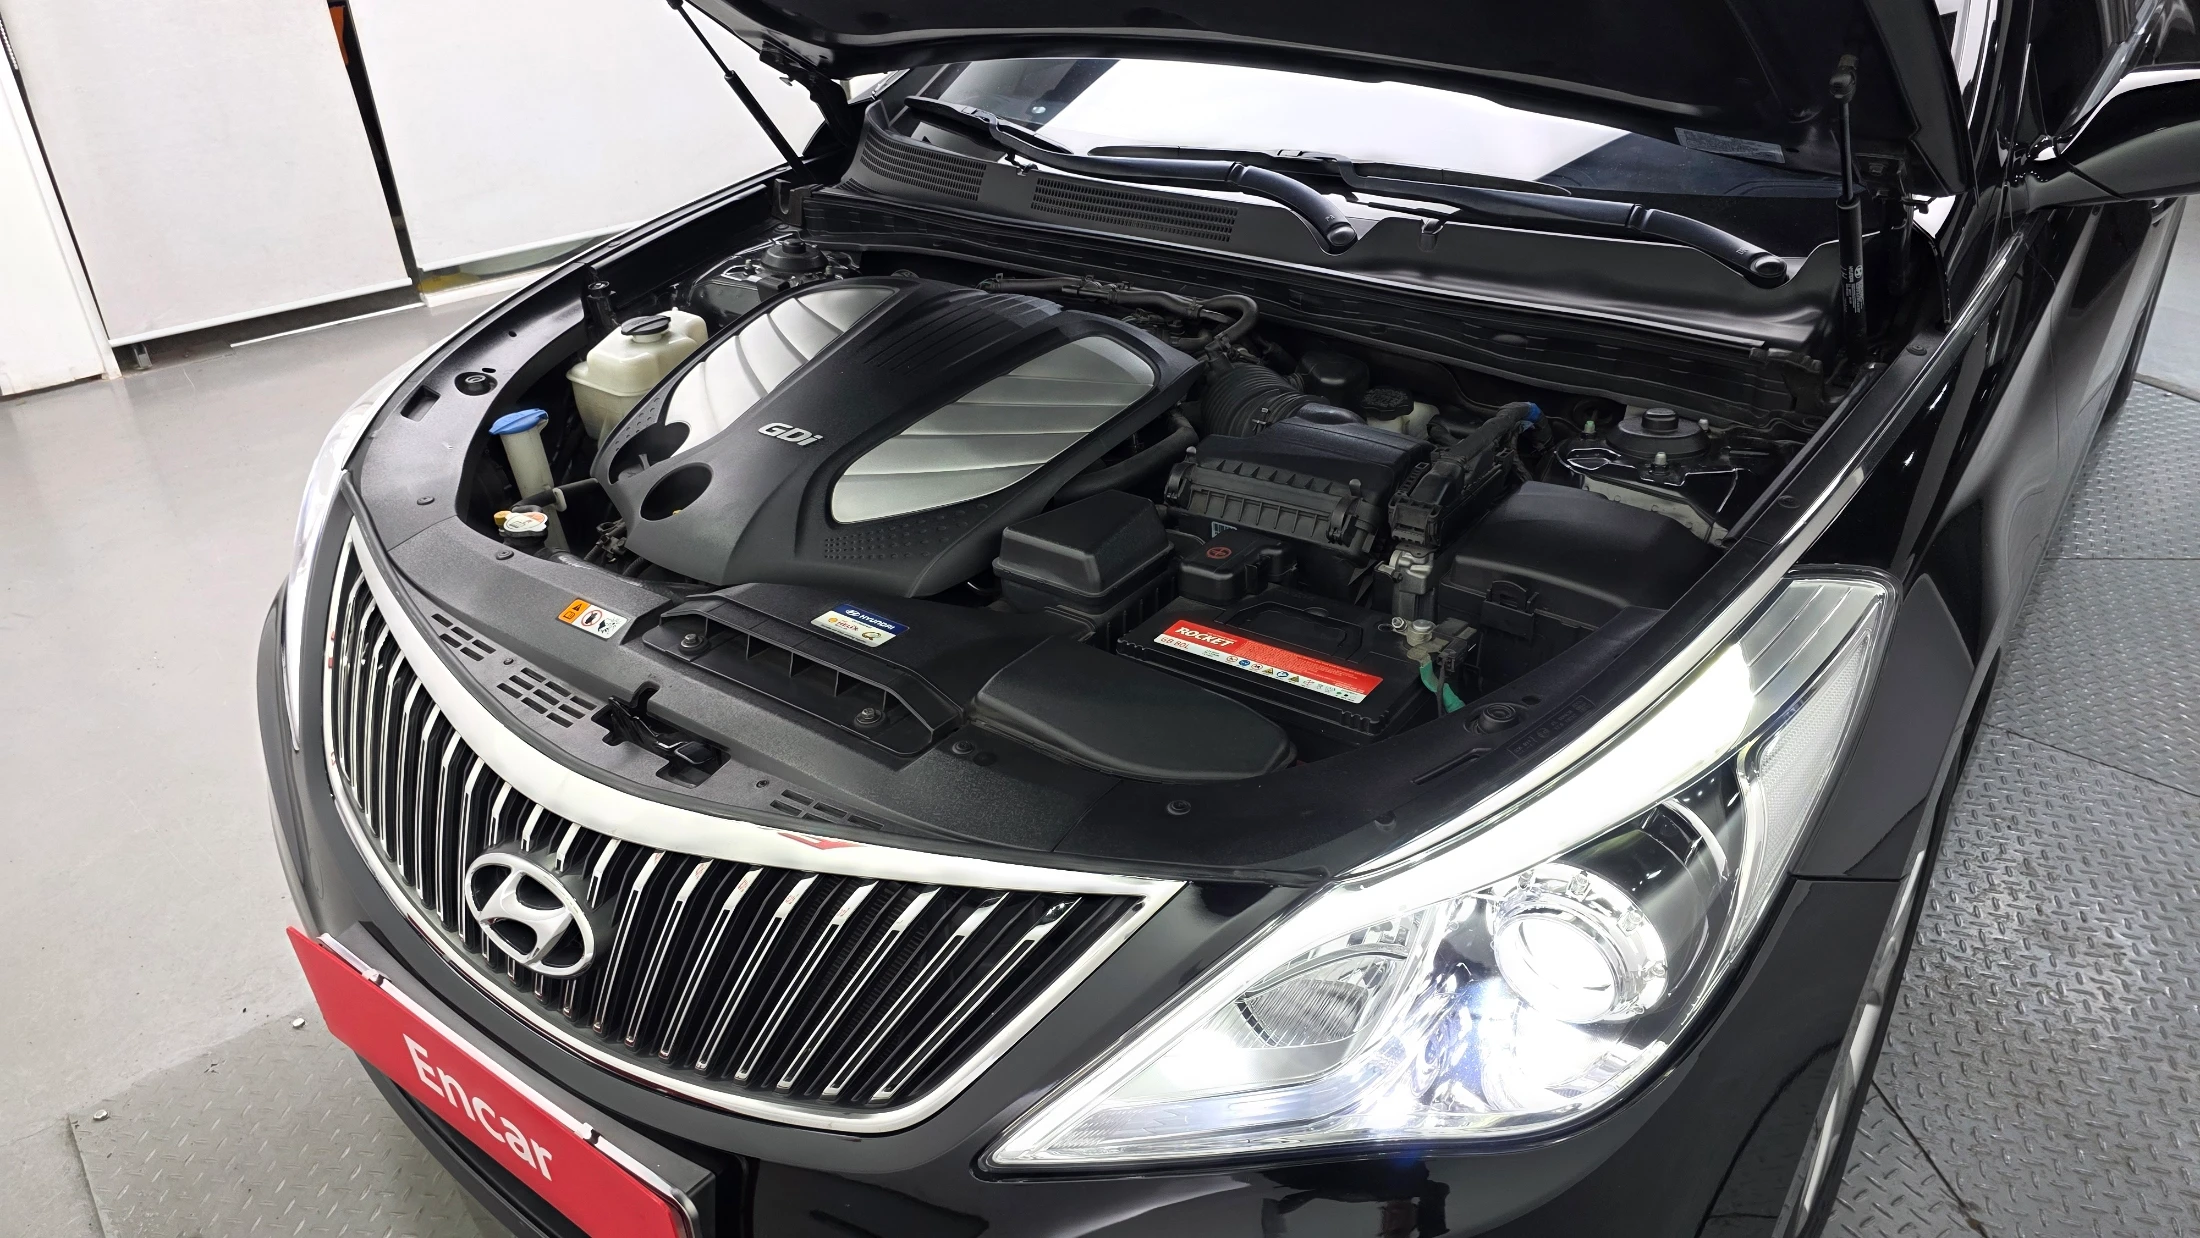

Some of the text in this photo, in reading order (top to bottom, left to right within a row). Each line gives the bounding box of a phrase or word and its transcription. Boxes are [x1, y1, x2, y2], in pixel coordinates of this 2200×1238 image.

[758, 422, 824, 446] GDi
[860, 614, 896, 630] HYUNDAI
[1175, 626, 1236, 648] ROCKET
[402, 1033, 552, 1181] Encar
